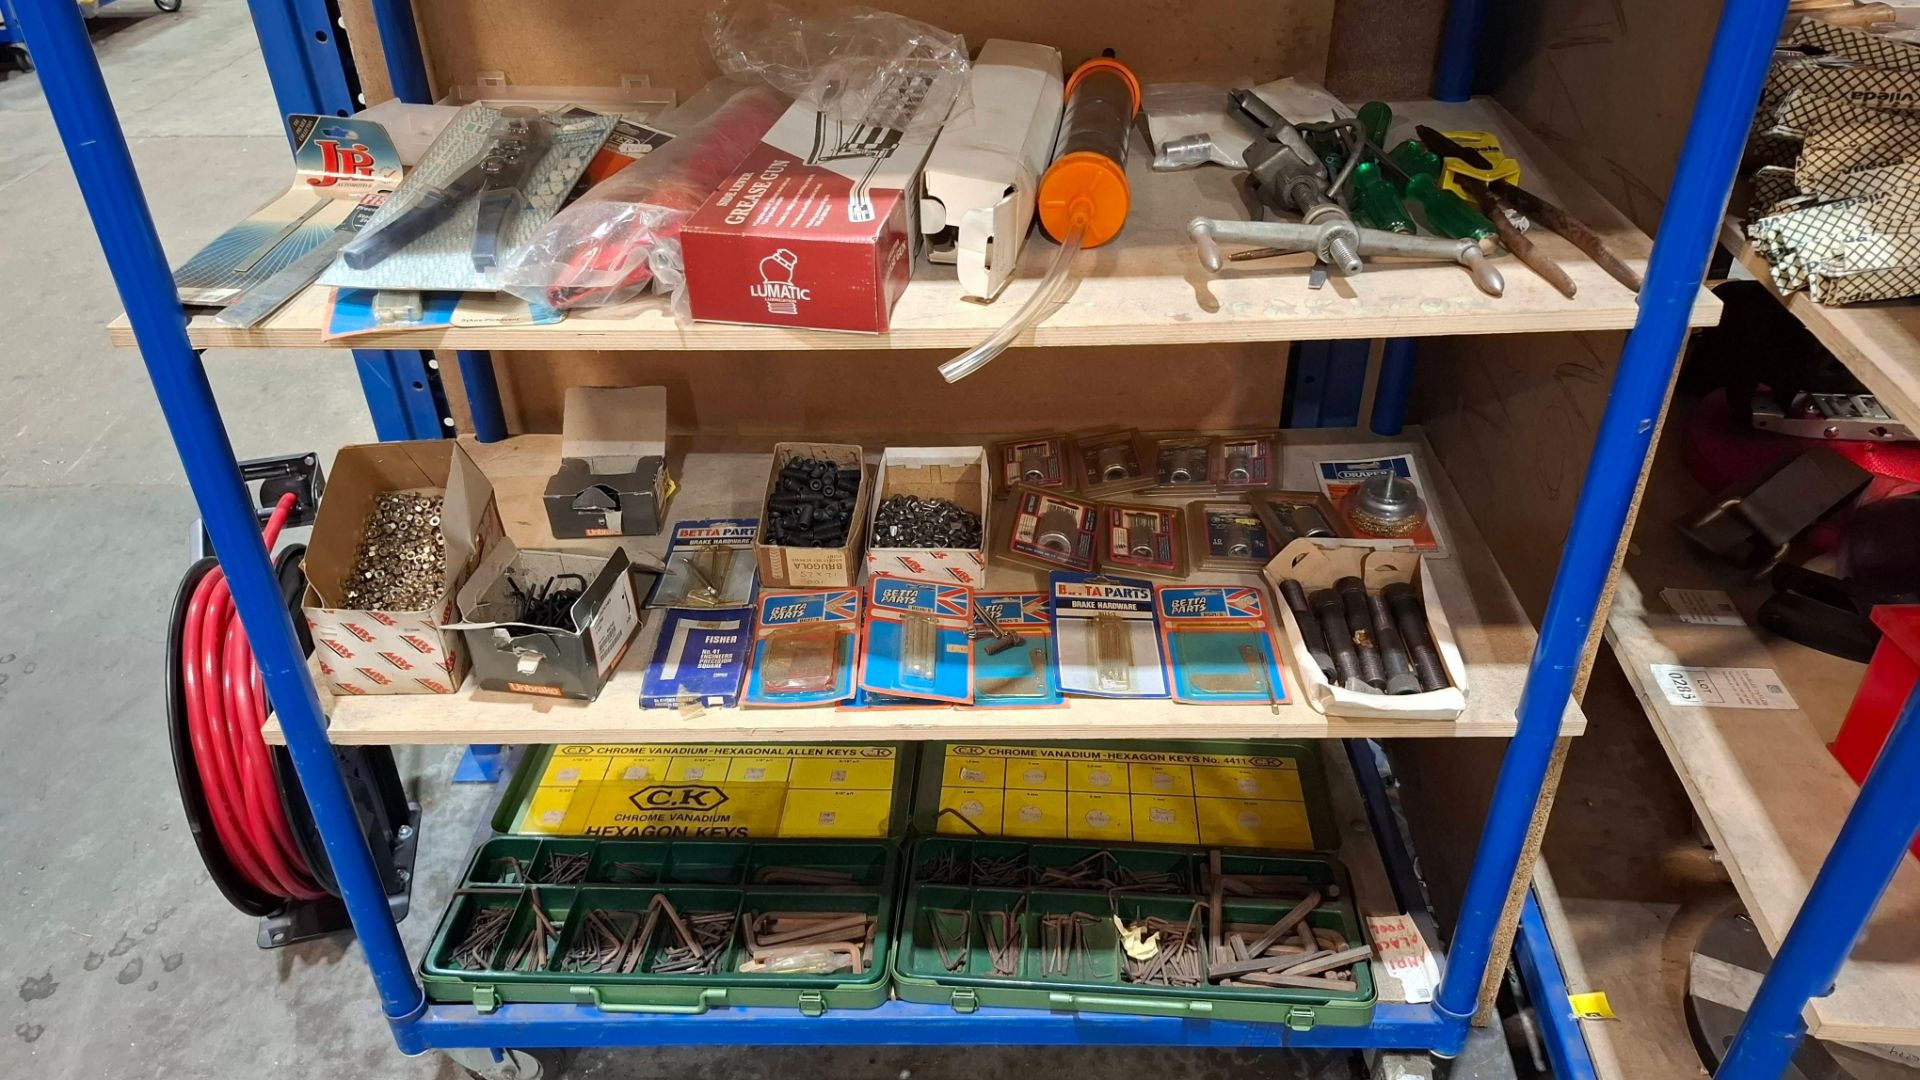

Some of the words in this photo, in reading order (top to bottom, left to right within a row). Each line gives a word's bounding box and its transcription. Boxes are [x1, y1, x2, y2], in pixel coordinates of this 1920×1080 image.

[1850, 91, 1914, 102] vileda
[1841, 156, 1905, 175] vileda
[724, 181, 773, 225] GREASE
[760, 159, 791, 181] GUN
[1831, 190, 1893, 212] vileda
[750, 284, 811, 301] LUMATIC
[679, 528, 721, 538] BETTA
[723, 527, 757, 537] PART
[794, 562, 843, 570] BRUGOLA
[883, 589, 919, 597] BETTA
[1058, 584, 1103, 597] BTA
[1105, 587, 1149, 599] PARTS
[881, 596, 917, 605] PARTS
[1071, 600, 1096, 609] BRAKE
[1097, 602, 1137, 611] HARDWARE
[1171, 597, 1207, 607] BETTA
[771, 603, 807, 615] BETTA
[1171, 604, 1207, 614] PARTS
[768, 610, 805, 622] PARTS
[345, 622, 377, 643] MBS
[403, 635, 436, 654] MBS
[704, 635, 738, 644] FISHER
[325, 639, 356, 659] MBS
[383, 651, 414, 671] MBS
[361, 667, 393, 685] MBS
[509, 682, 562, 695] Unbrako
[1696, 679, 1712, 694] LOT
[1168, 754, 1200, 763] KEYS
[1202, 755, 1220, 764] No.
[1223, 757, 1246, 765] 4411
[614, 813, 665, 822] CHROME
[669, 813, 731, 822] VANADIUM
[585, 825, 689, 837] HEXAGON
[695, 826, 749, 837] KEYS
